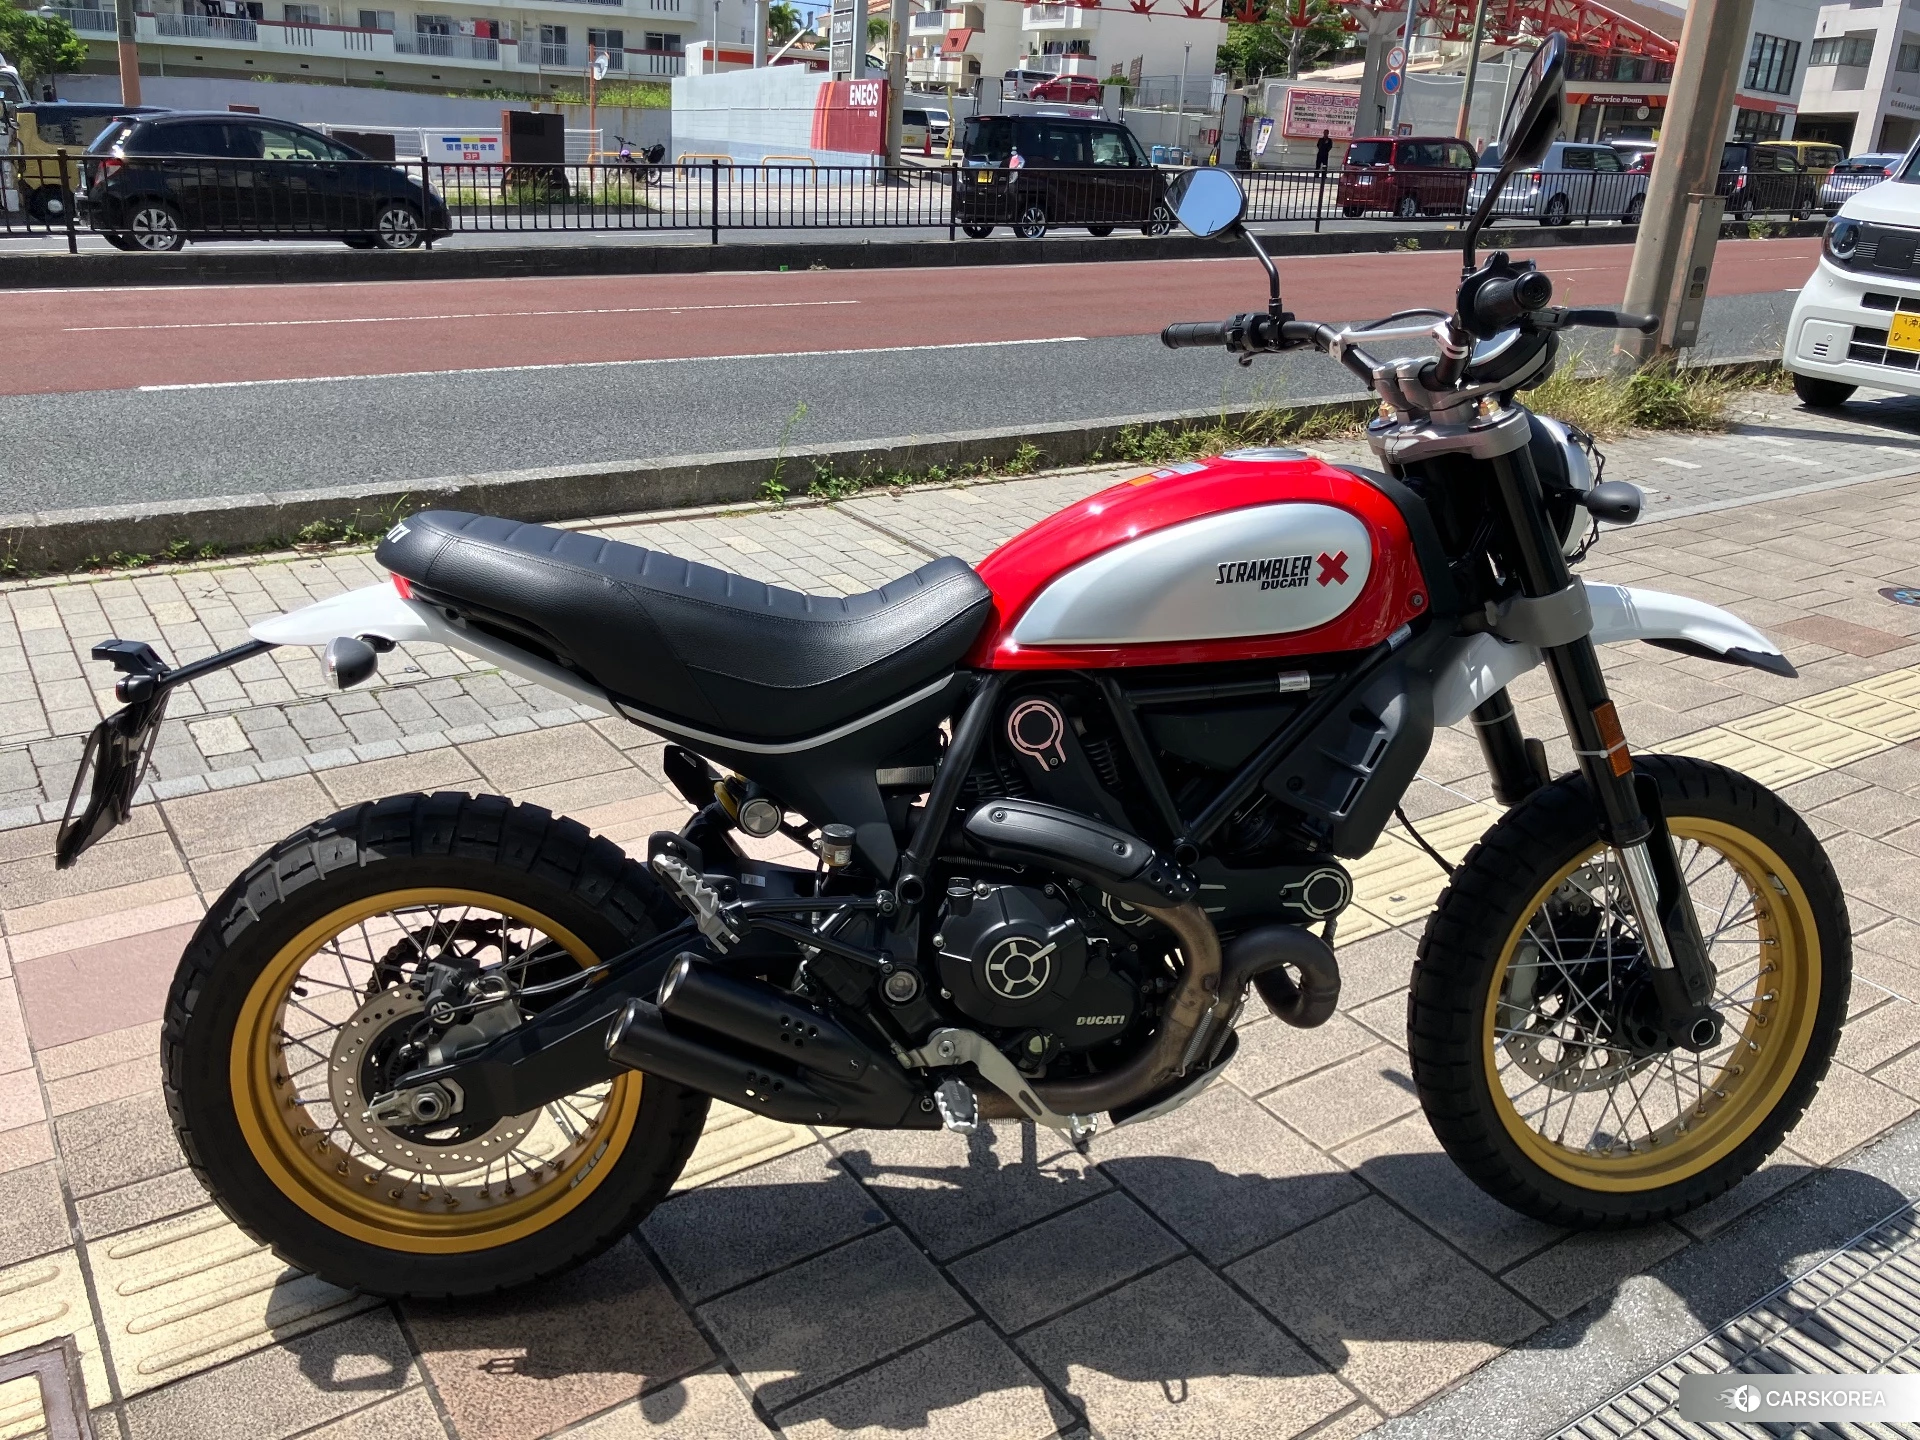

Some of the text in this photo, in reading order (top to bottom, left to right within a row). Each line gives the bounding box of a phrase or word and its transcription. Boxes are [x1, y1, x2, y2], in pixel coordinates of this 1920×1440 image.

[849, 83, 879, 106] ENEOS
[1592, 95, 1643, 104] Service Room
[1215, 555, 1312, 584] SCRAMBLER
[1260, 577, 1309, 590] DUCATI
[1076, 1015, 1126, 1026] DUCATI
